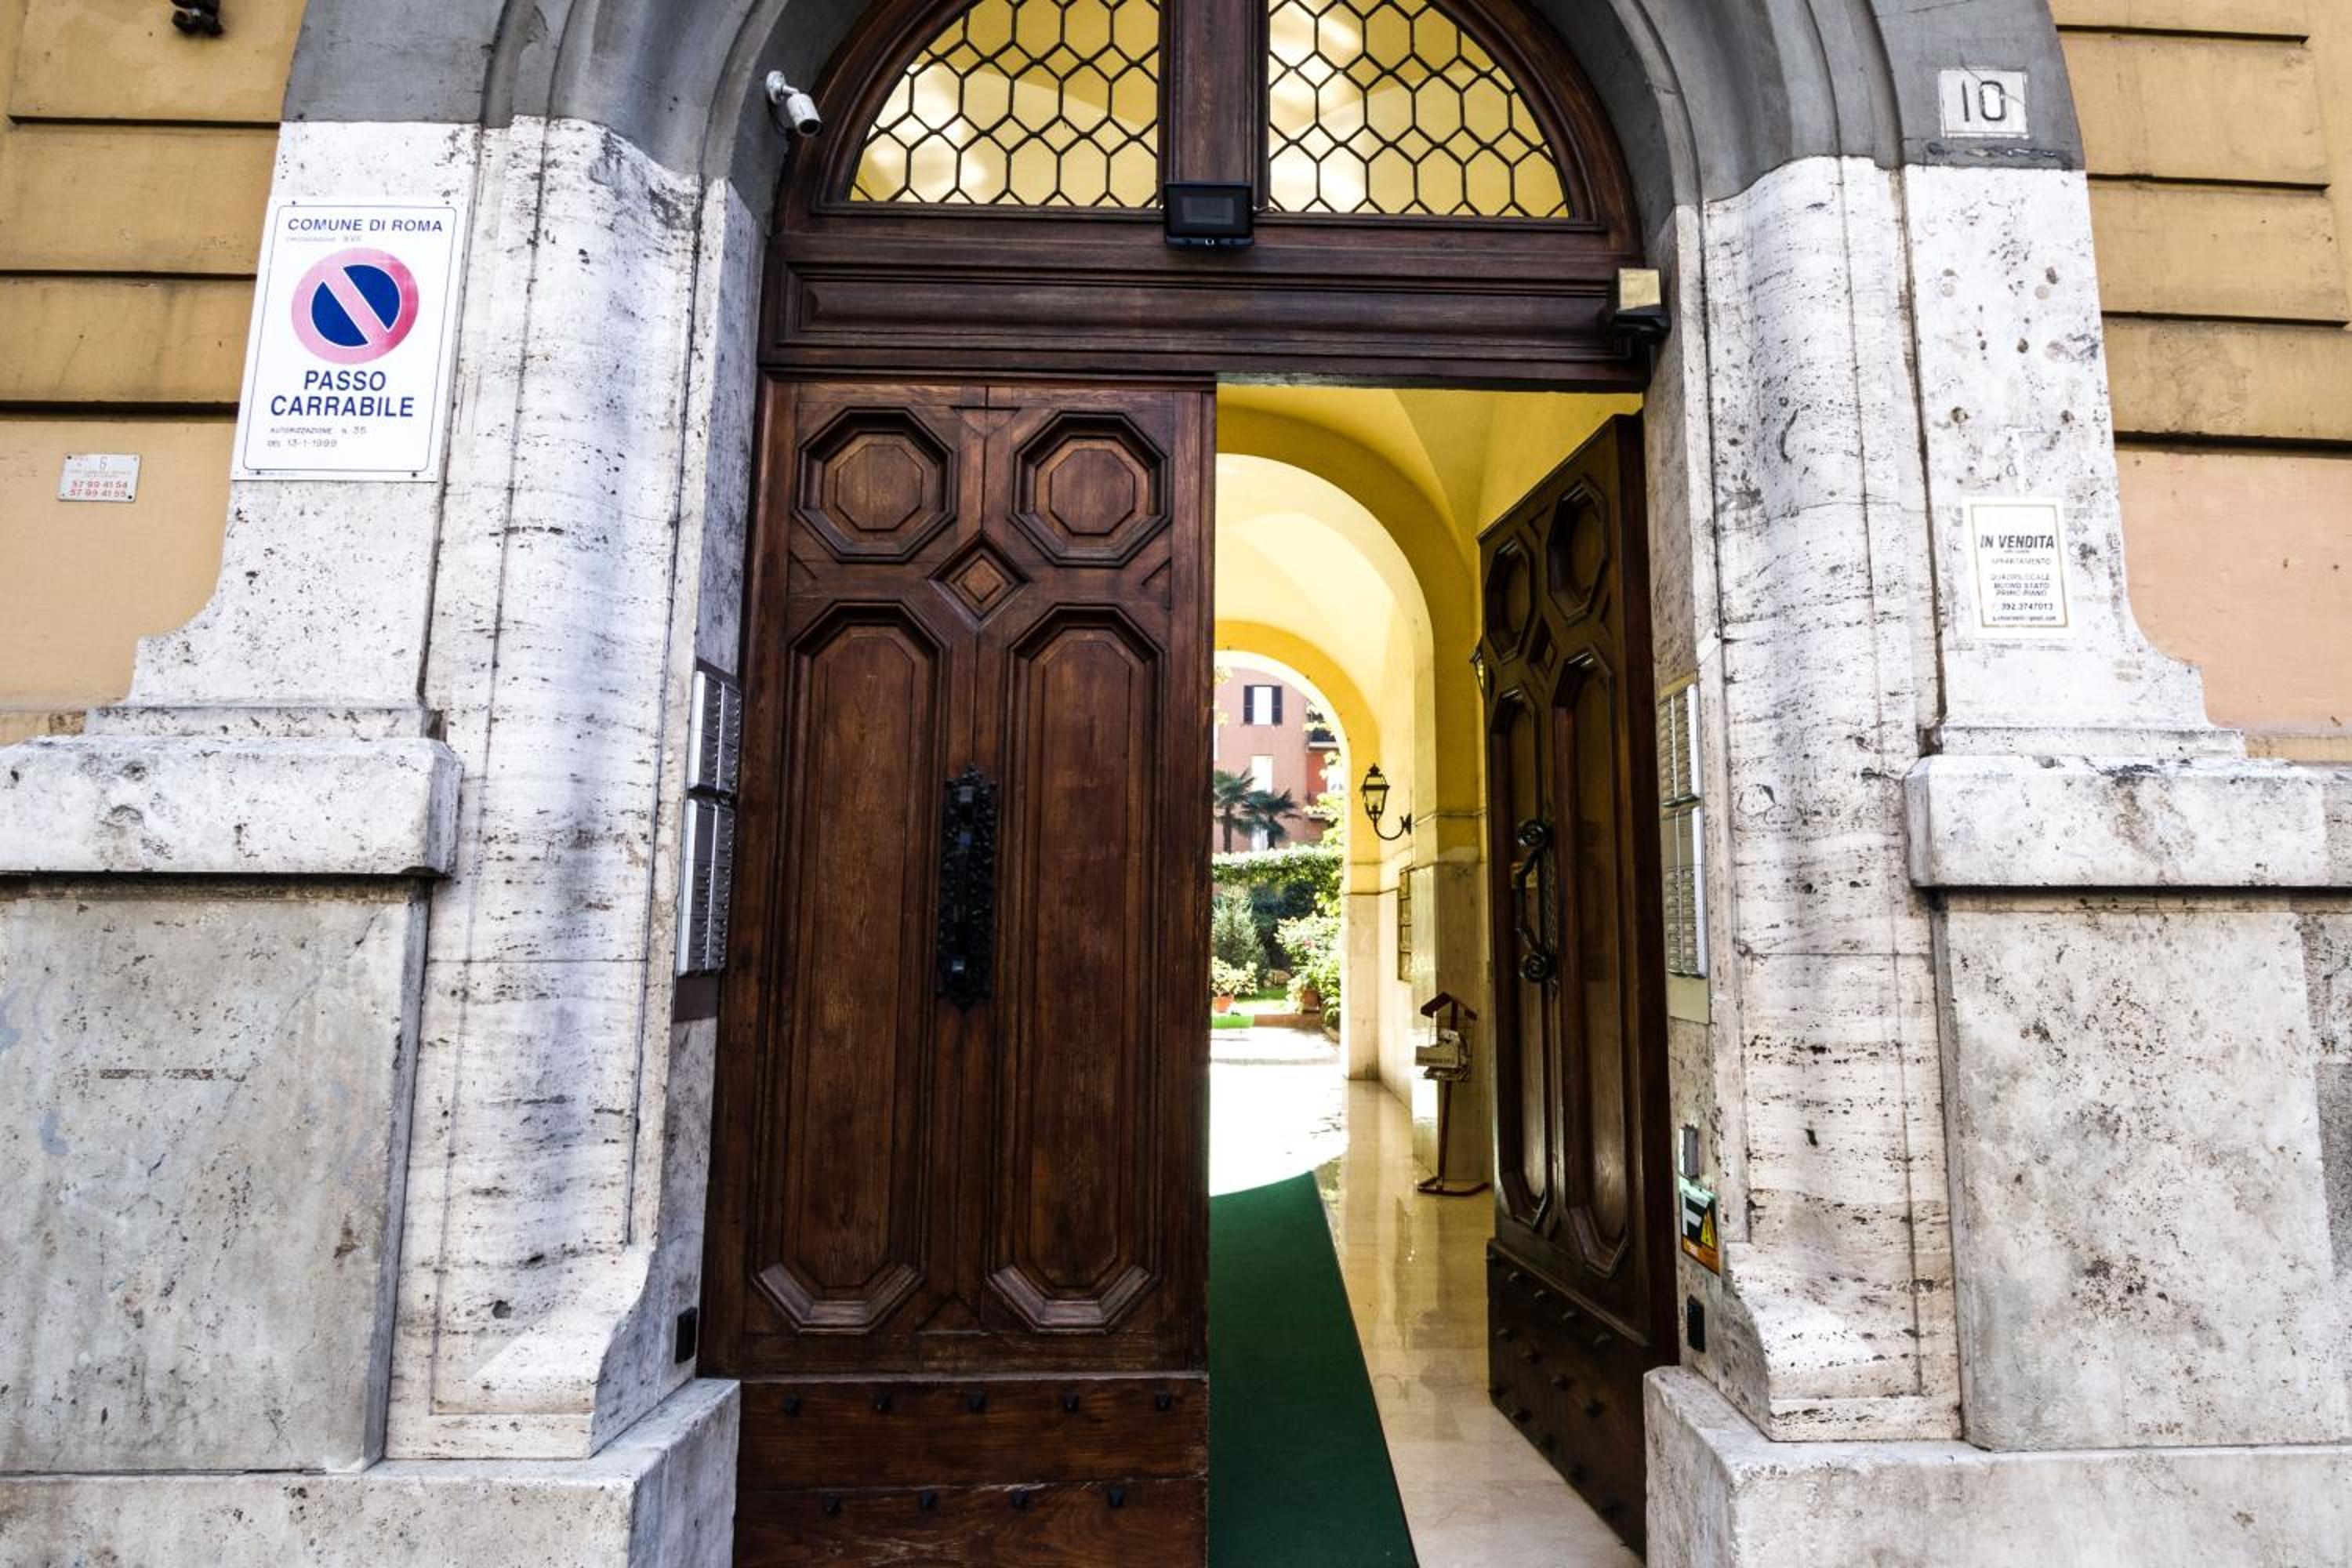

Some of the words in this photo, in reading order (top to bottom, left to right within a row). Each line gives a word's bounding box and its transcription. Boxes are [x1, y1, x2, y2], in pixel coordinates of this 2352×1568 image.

[1962, 80, 2006, 122] 10
[288, 219, 362, 230] COMUNE
[369, 219, 387, 232] DI
[391, 219, 443, 233] ROMA
[303, 369, 387, 391] PASSO
[270, 395, 414, 416] CARRABILE
[1980, 535, 1994, 548] IN
[1998, 535, 2054, 549] VENDITA
